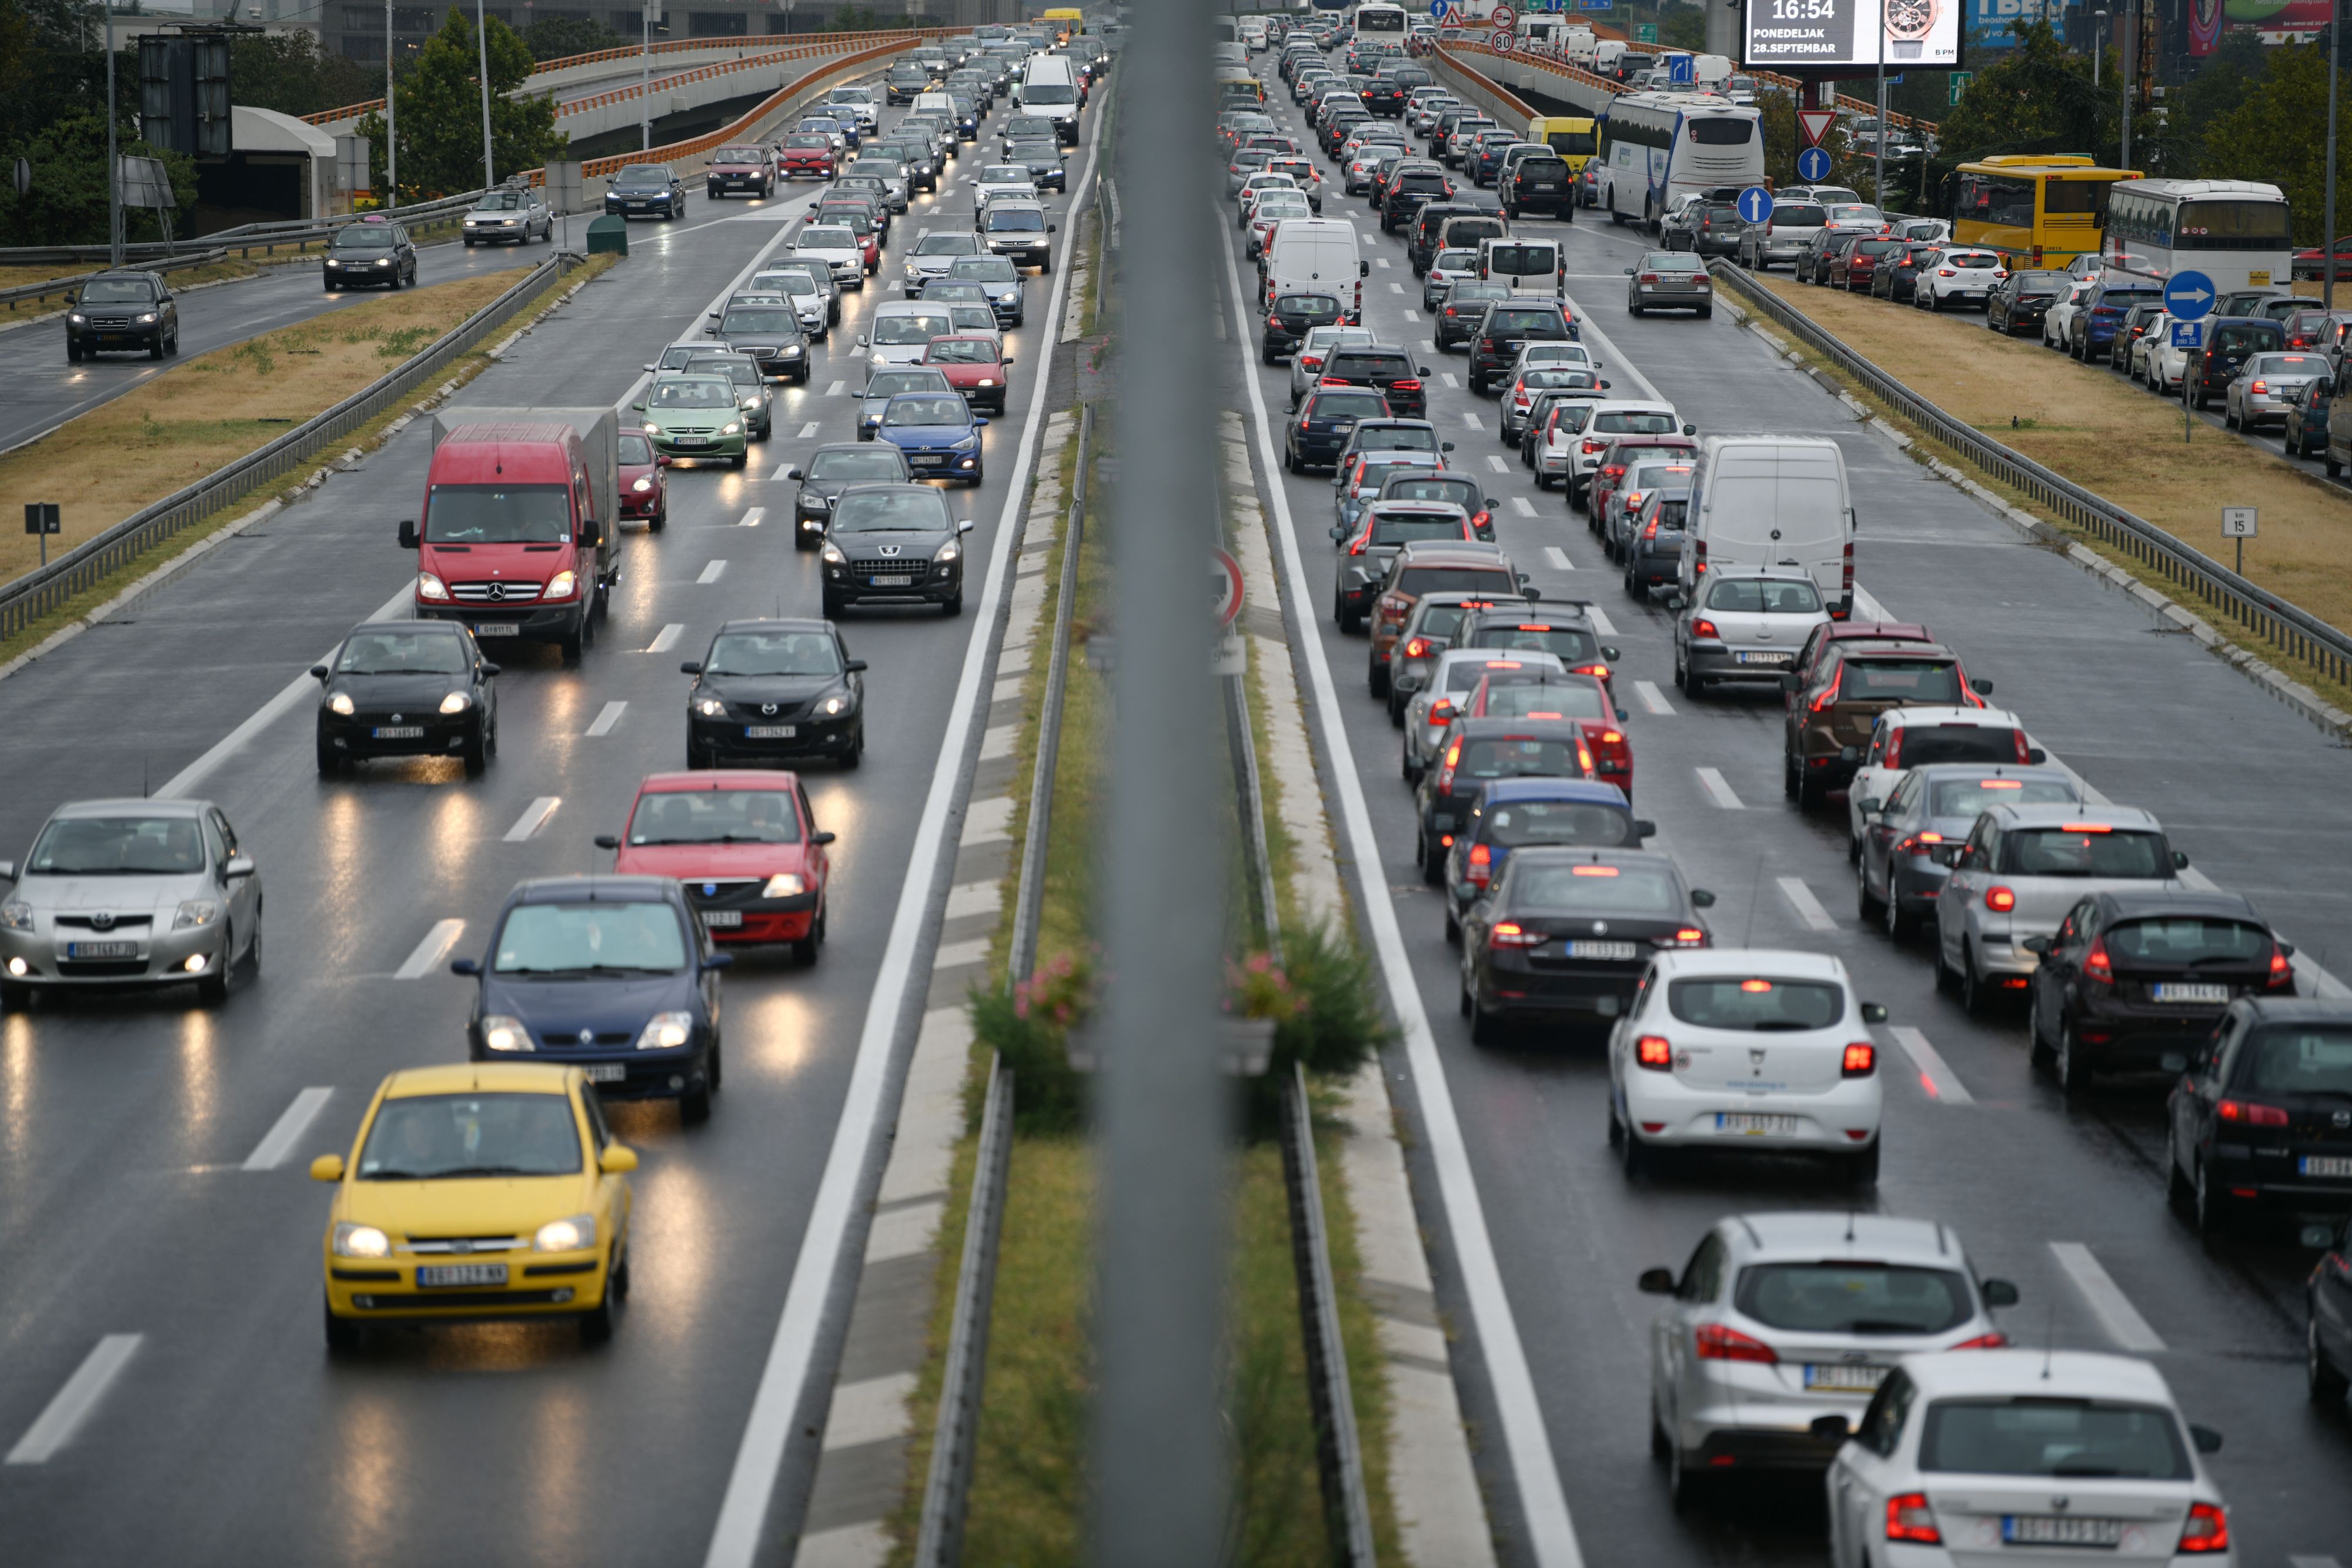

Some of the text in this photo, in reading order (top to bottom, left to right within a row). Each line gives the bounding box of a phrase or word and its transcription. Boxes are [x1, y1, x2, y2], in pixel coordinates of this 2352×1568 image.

[1773, 0, 1835, 18] 16:54
[1753, 29, 1825, 38] PONEDELJAK
[1496, 36, 1510, 48] 80
[1753, 44, 1836, 53] 28.SEPTEMBAR
[2234, 521, 2244, 532] 15
